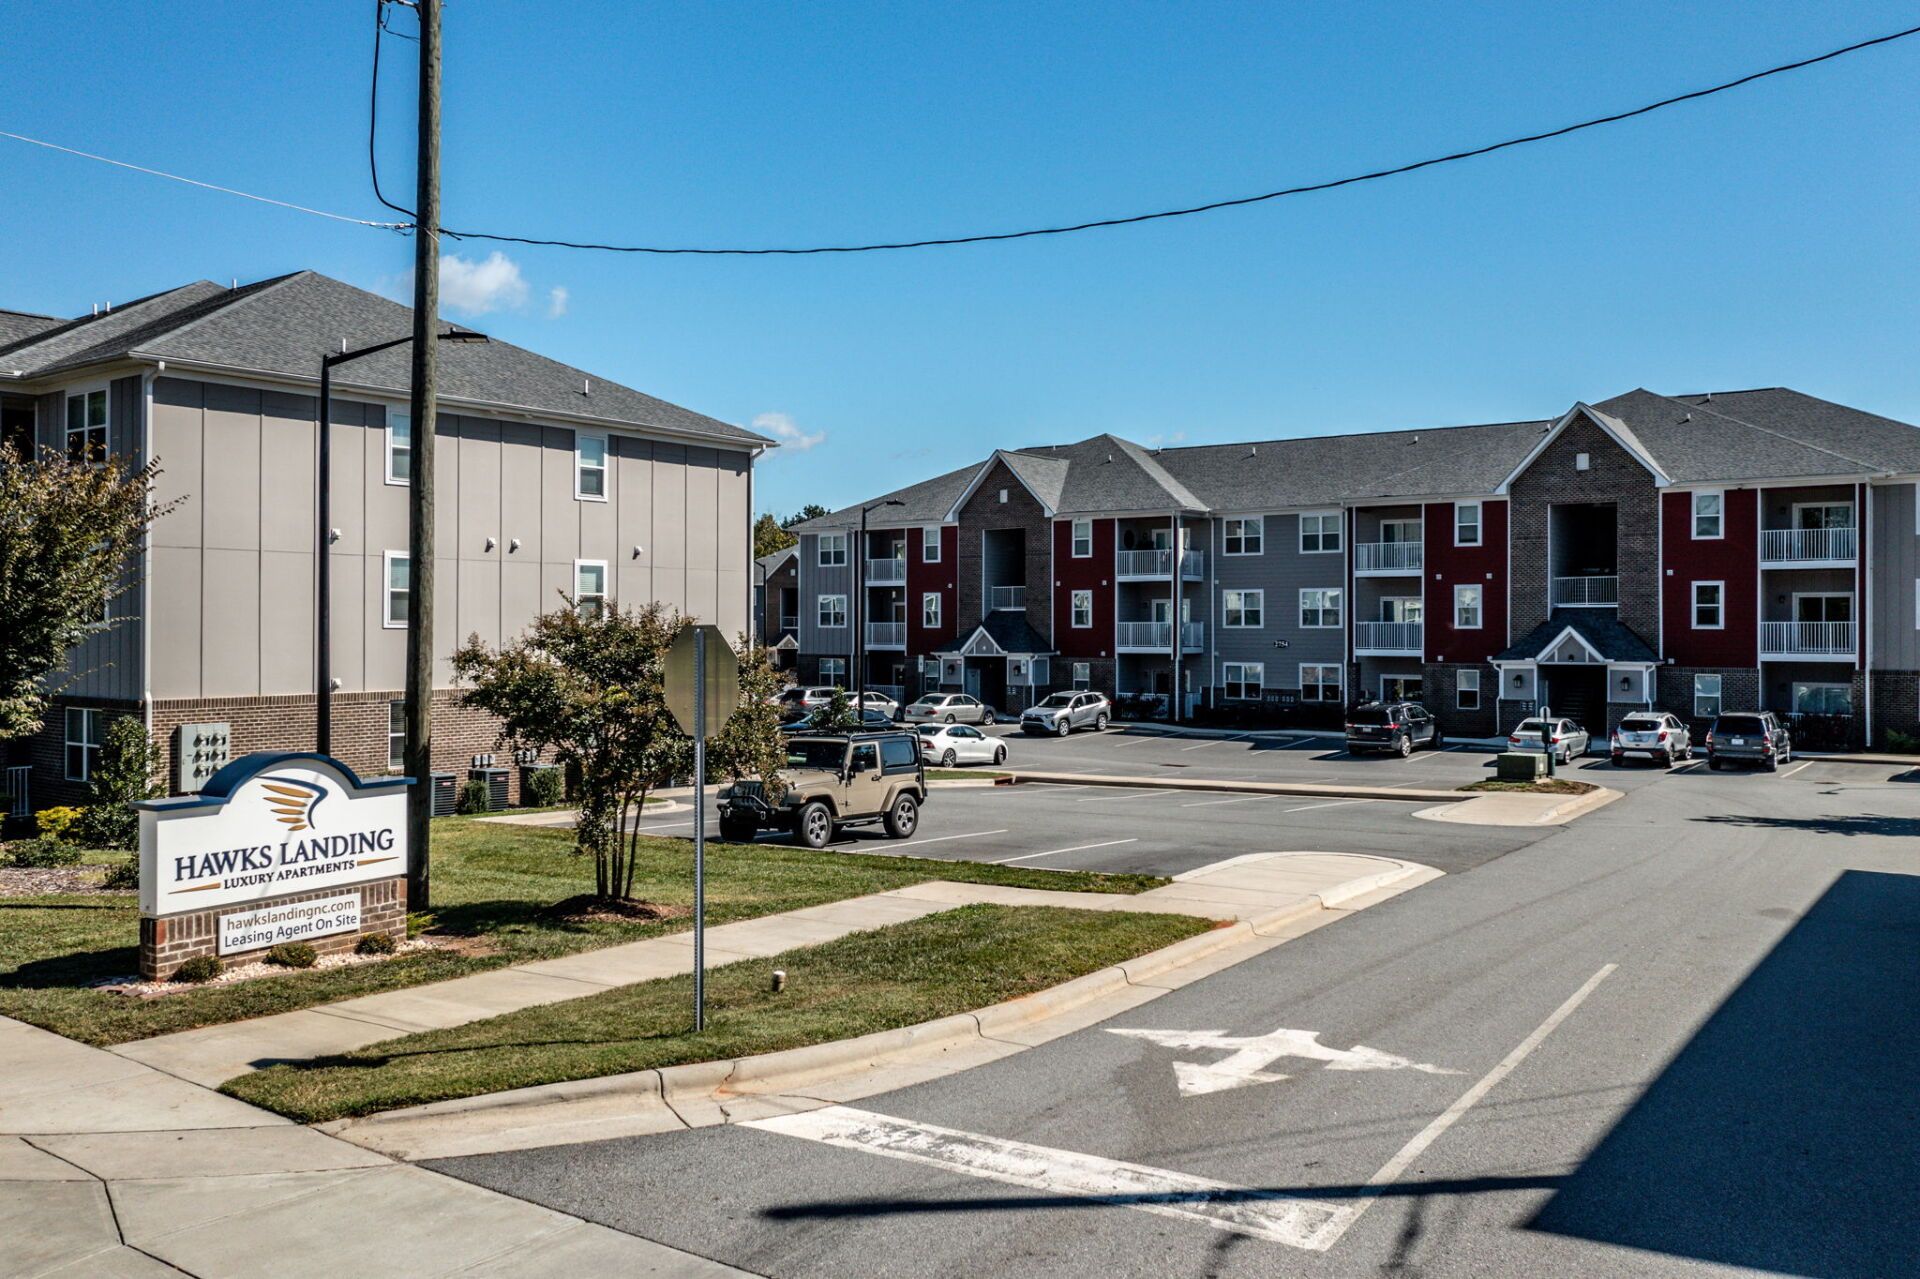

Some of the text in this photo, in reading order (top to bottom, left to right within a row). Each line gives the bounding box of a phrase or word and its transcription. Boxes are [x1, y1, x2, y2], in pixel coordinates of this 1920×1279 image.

[174, 828, 395, 881] HAWKS LANDING
[223, 859, 355, 890] LUXURY APARTMENTS
[224, 912, 358, 948] Leasing Agent On Site
[226, 899, 355, 931] hawkslandingnc.com
